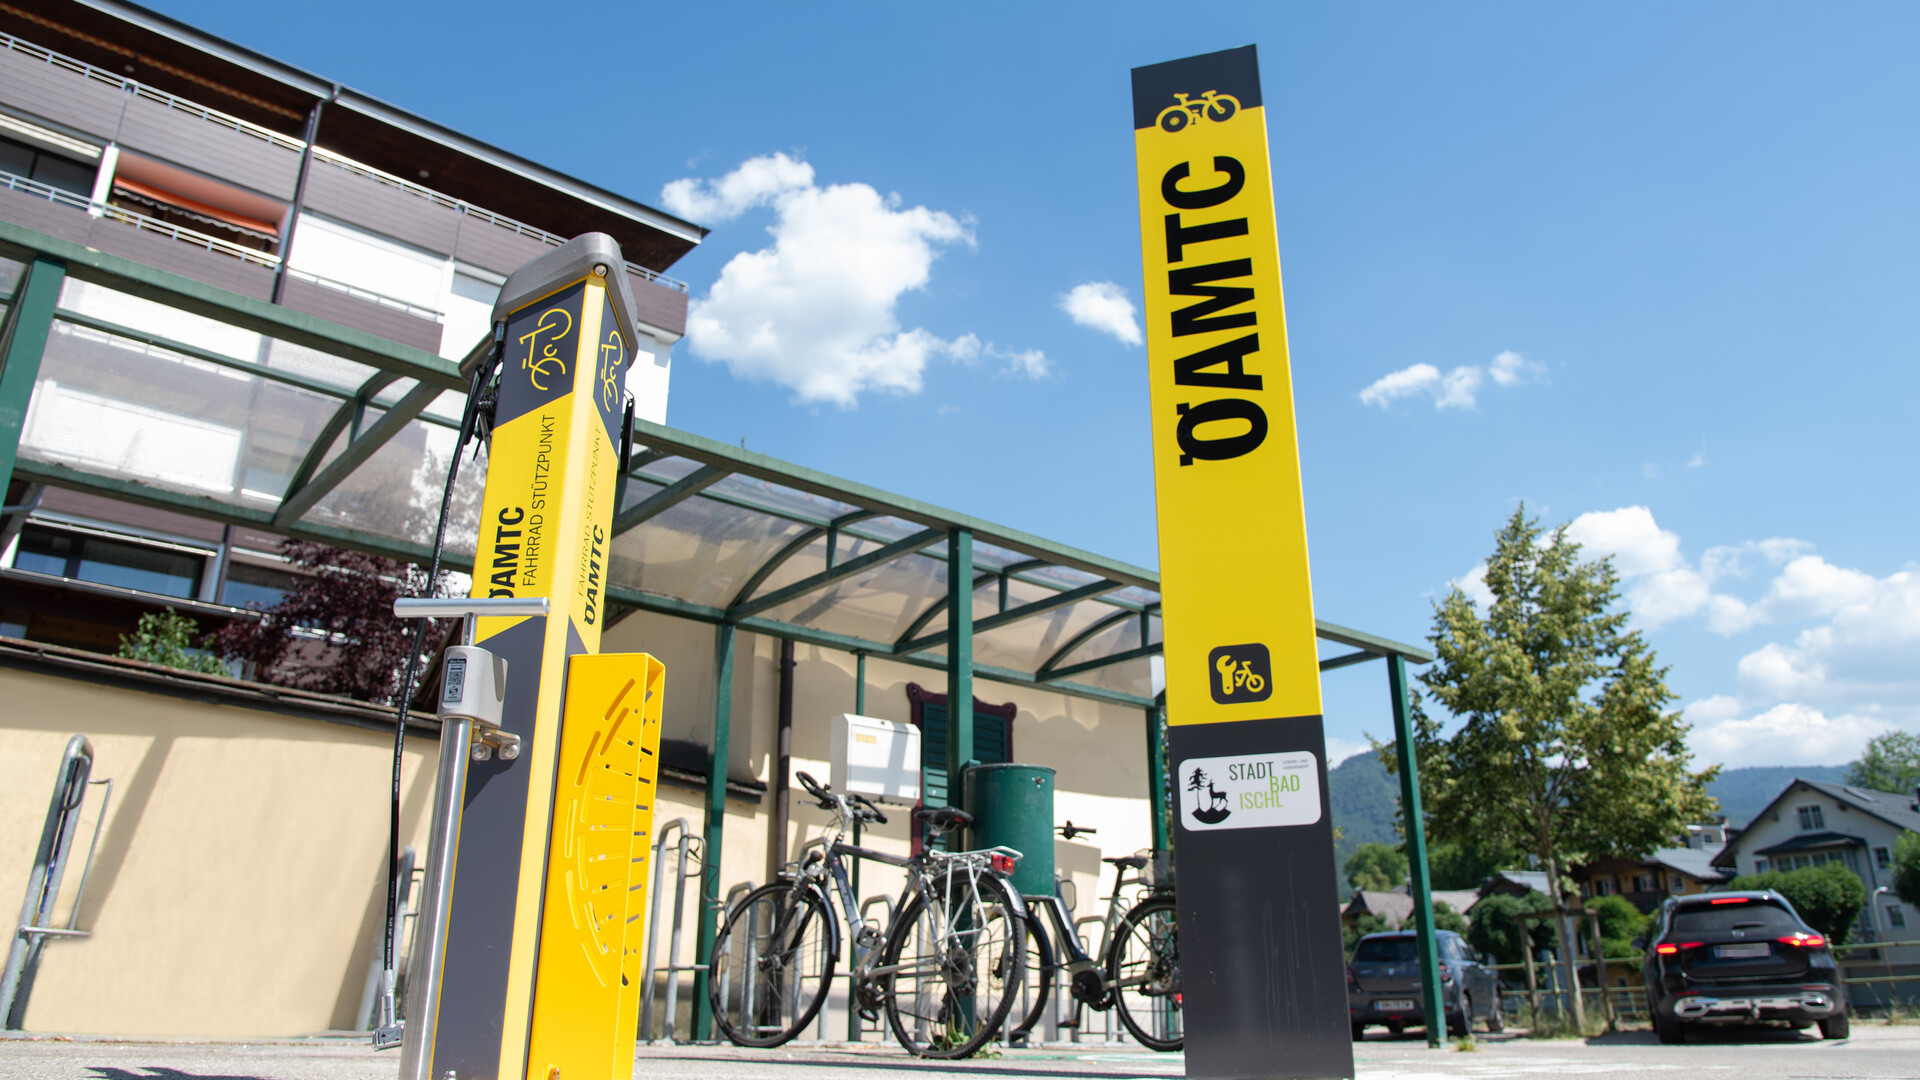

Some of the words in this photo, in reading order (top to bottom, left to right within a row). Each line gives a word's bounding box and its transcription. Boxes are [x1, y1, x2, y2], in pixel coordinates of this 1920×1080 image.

[1161, 156, 1268, 467] ÖAMTC
[531, 414, 555, 509] STÜTZPUNKT
[523, 514, 544, 586] FAHRRAD
[578, 525, 591, 597] FAHRRAD
[586, 428, 602, 522] STÜTZPUNKT
[584, 524, 604, 626] ÖAMTC
[1229, 761, 1274, 781] STADT
[1239, 791, 1284, 810] ISCHL
[1270, 774, 1300, 793] BAD
